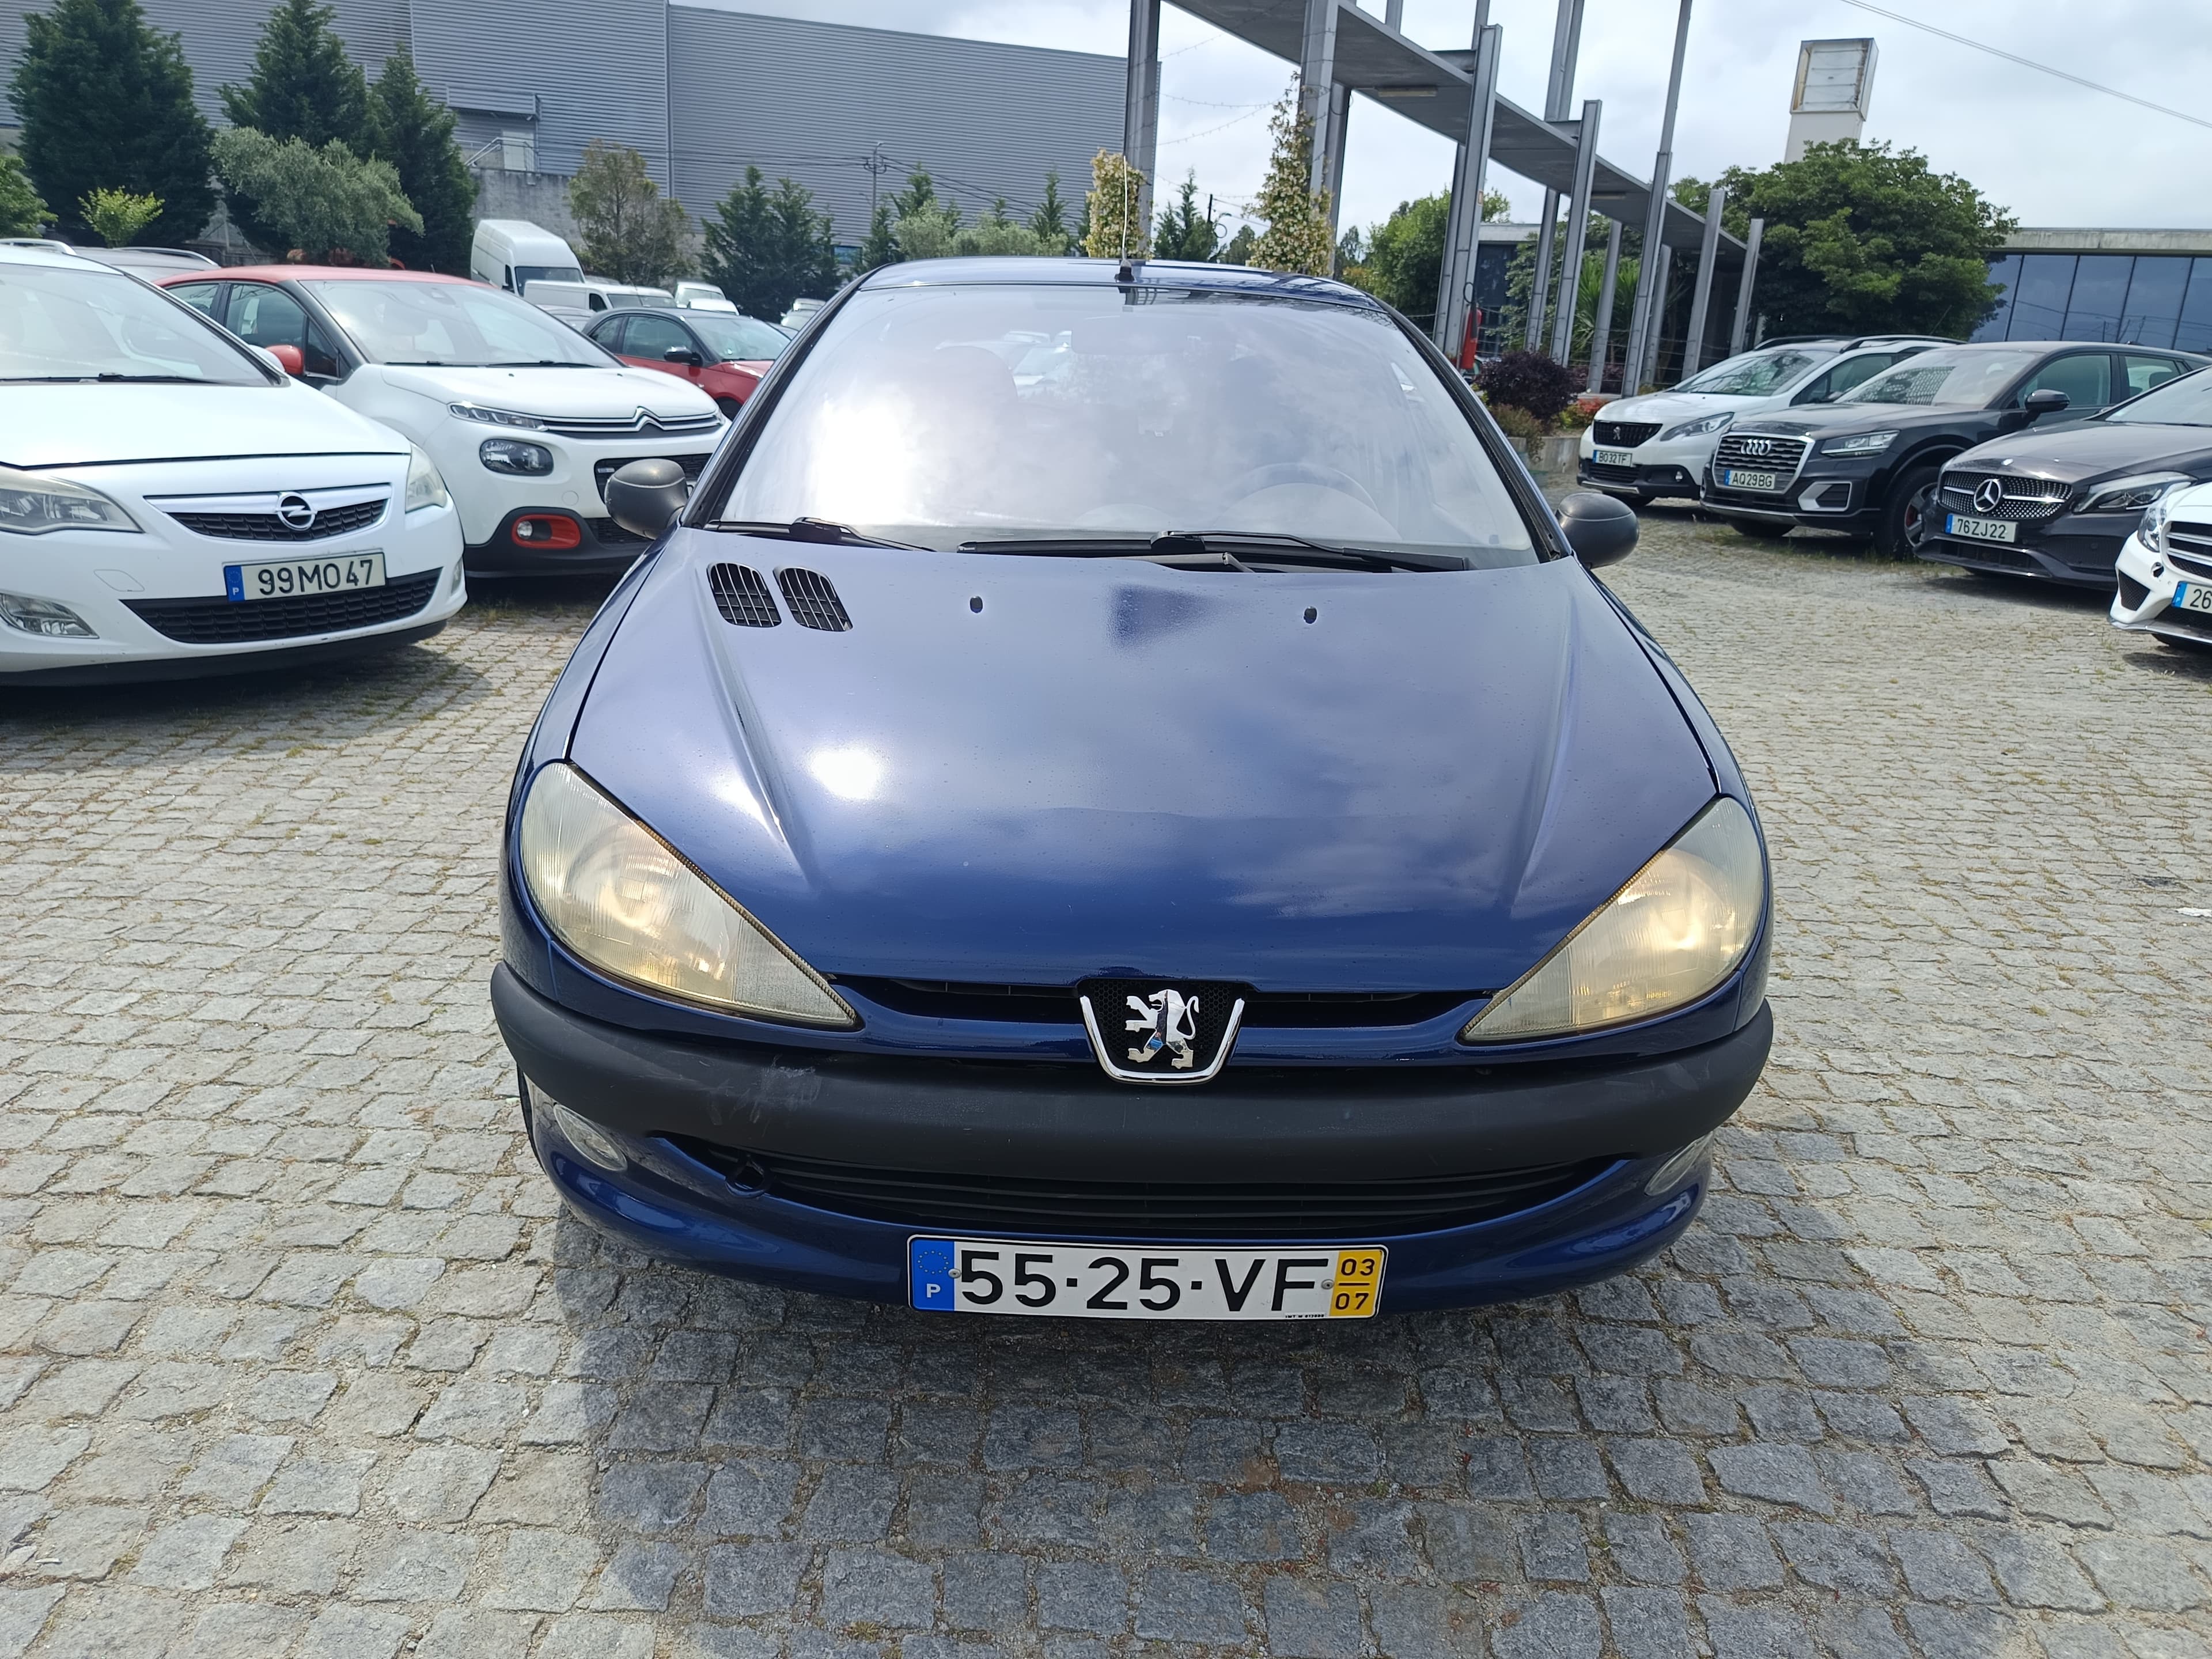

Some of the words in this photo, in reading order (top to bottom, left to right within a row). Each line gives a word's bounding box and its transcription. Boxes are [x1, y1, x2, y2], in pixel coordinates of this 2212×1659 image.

[1732, 472, 1772, 487] AQ29BG
[1957, 519, 2006, 539] 76ZJ22
[233, 587, 239, 595] P
[1340, 1258, 1376, 1277] 03
[926, 1283, 941, 1298] P
[1335, 1292, 1369, 1310] 07
